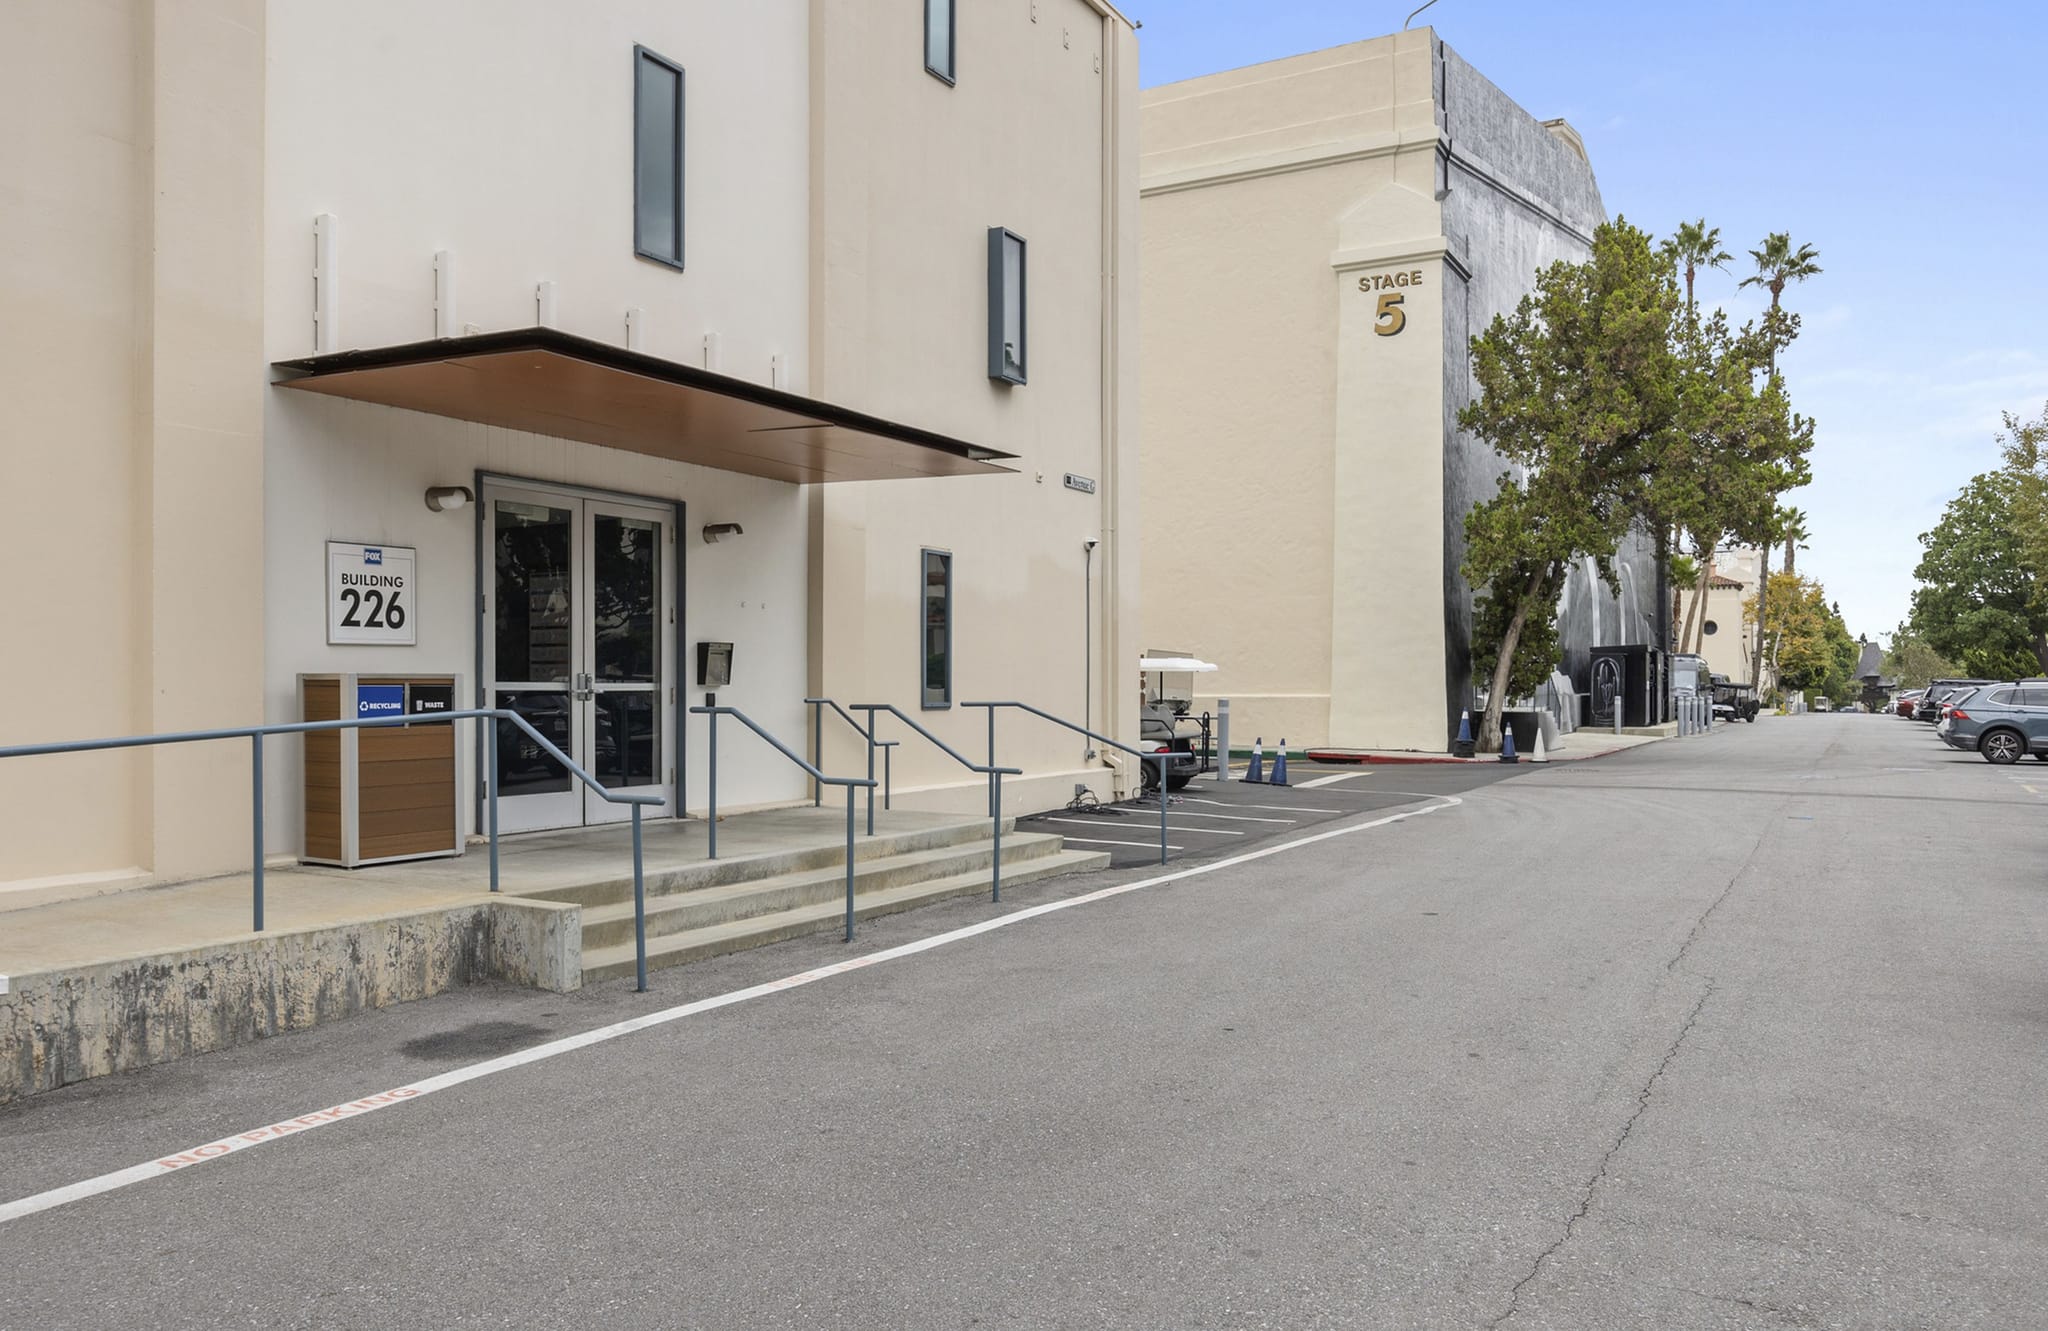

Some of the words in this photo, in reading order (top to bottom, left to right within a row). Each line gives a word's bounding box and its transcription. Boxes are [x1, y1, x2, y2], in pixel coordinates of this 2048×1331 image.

[1358, 270, 1423, 293] STAGE
[1374, 292, 1407, 337] 5
[364, 551, 382, 562] FOX
[341, 573, 404, 588] BUILDING
[340, 588, 406, 630] 226
[369, 702, 402, 710] RECYCLING
[424, 701, 444, 709] WASTE
[157, 1143, 231, 1169] NO
[238, 1086, 423, 1142] PARKING
